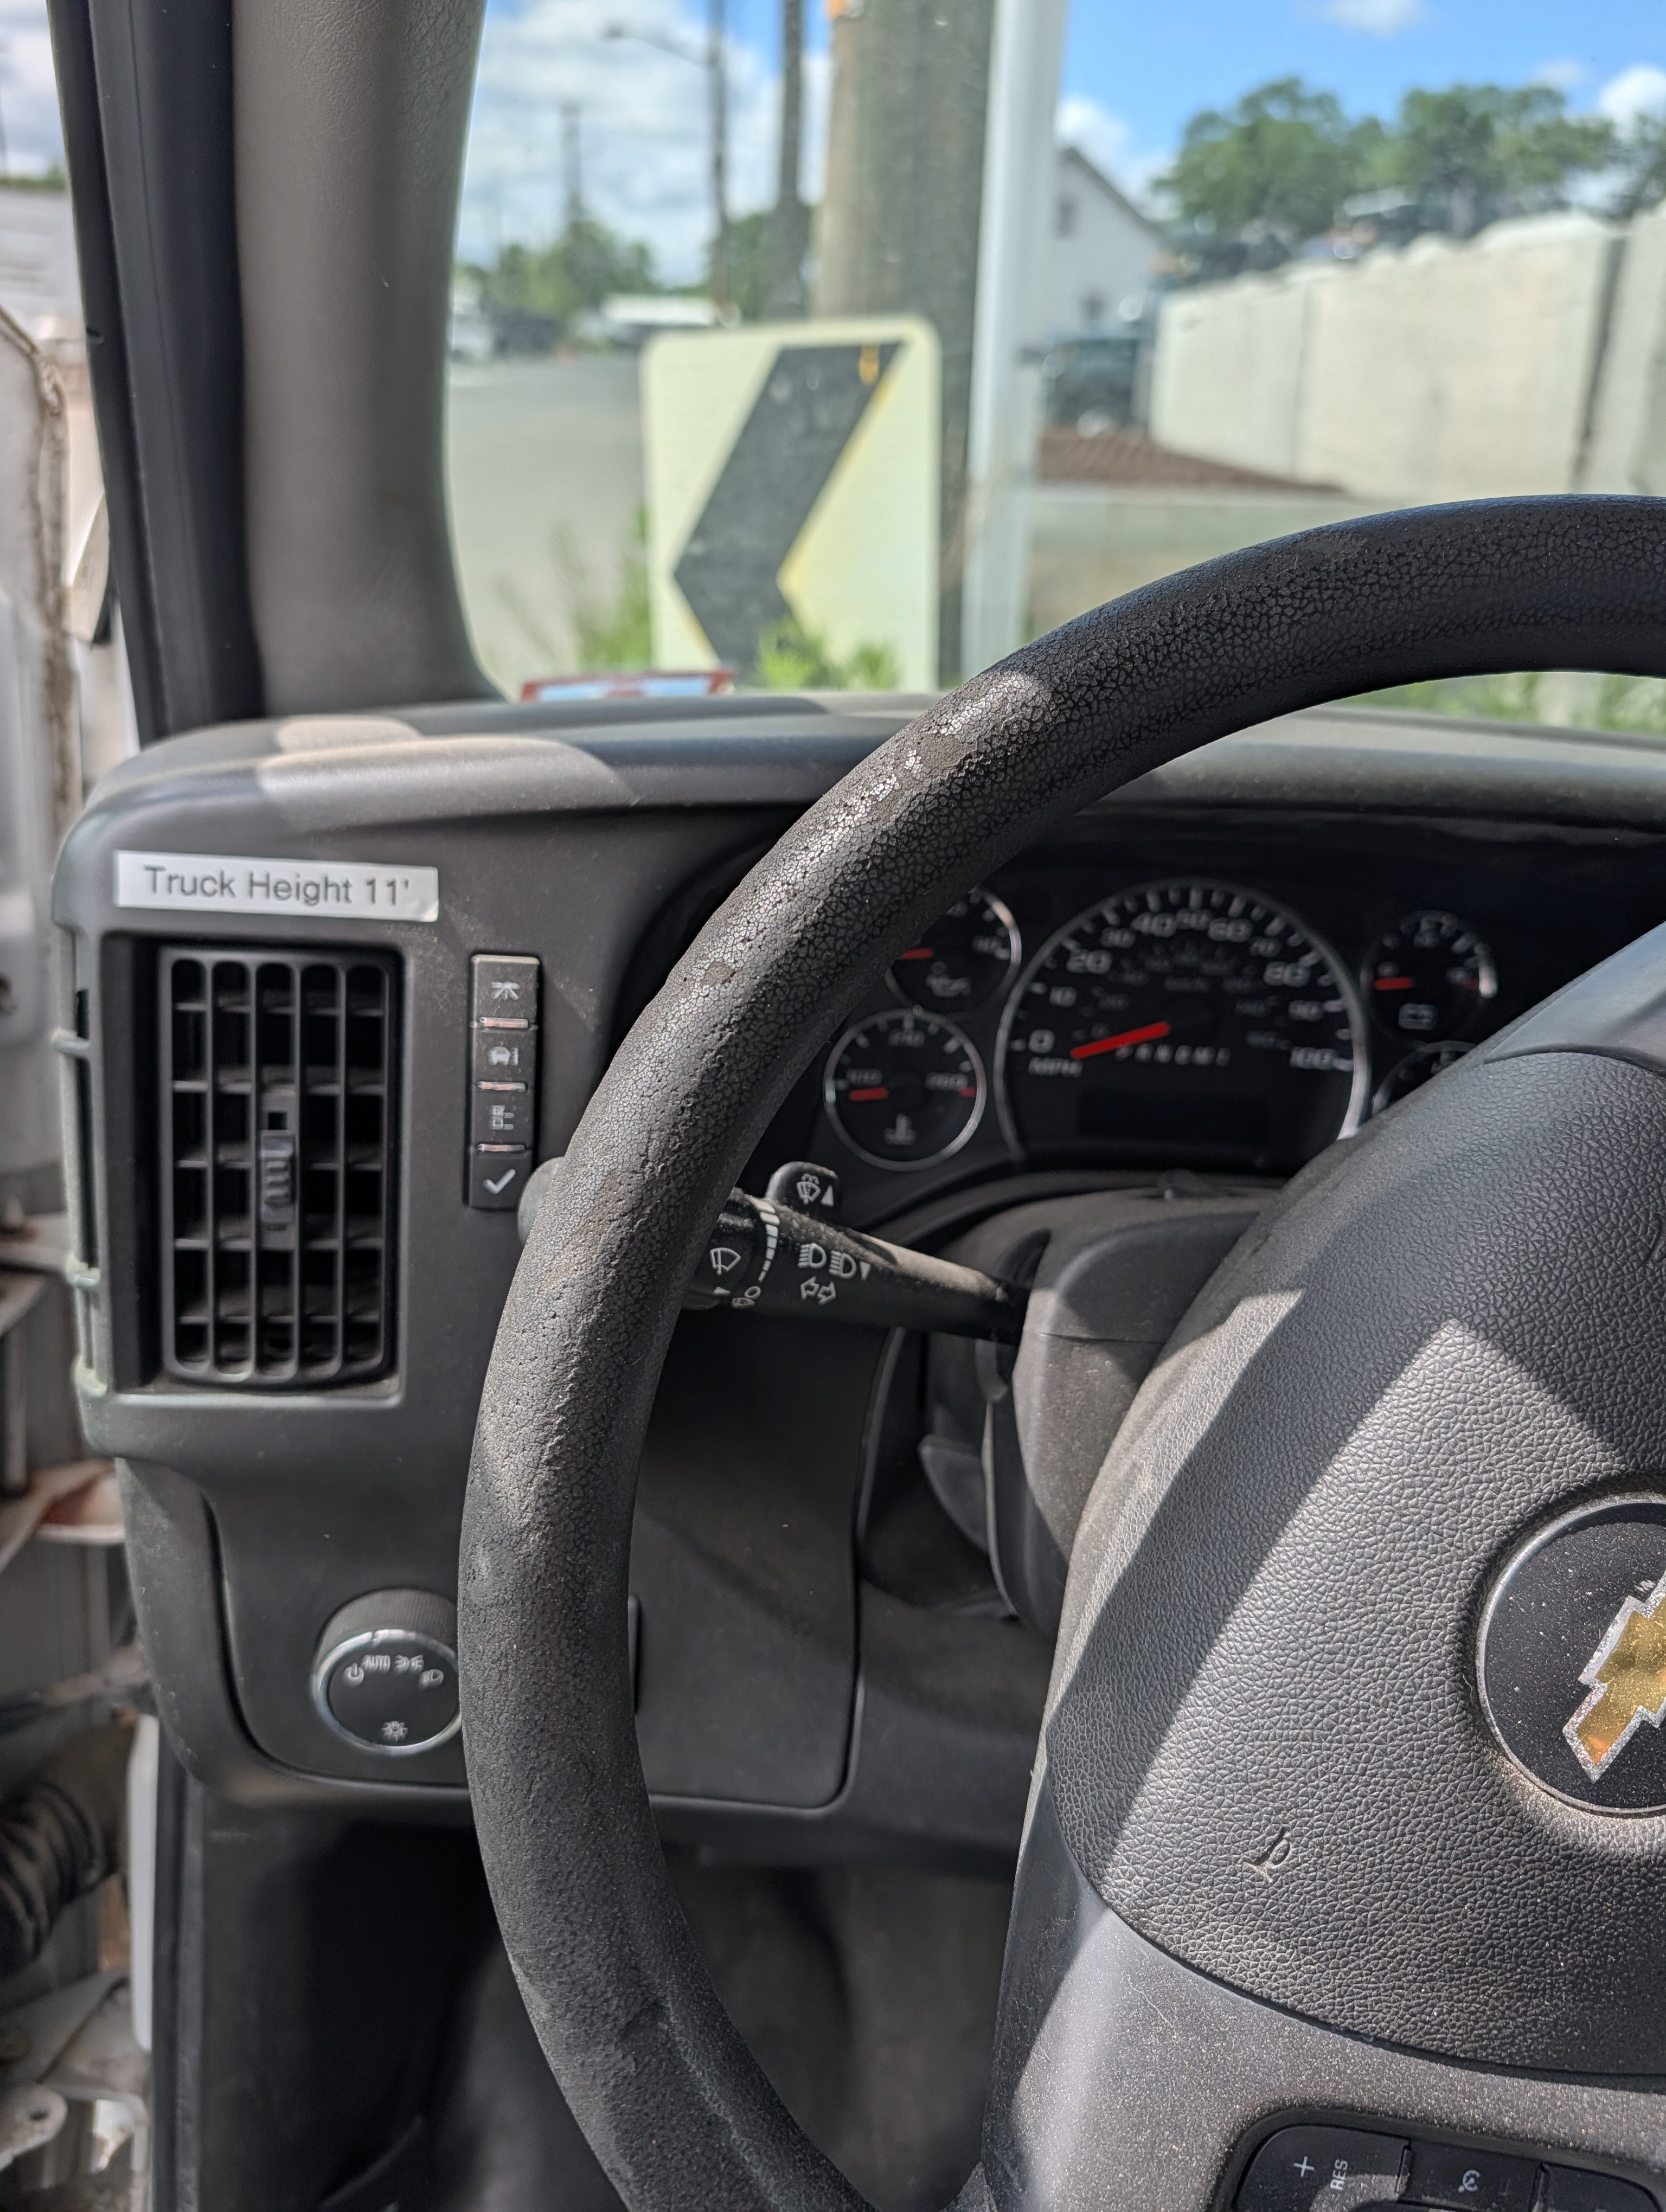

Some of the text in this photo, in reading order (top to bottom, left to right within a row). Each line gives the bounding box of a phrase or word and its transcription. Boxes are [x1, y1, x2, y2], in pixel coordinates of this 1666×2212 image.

[144, 865, 409, 906] Truck Height 11'
[1130, 912, 1176, 937] 40
[1066, 949, 1112, 973] 20
[1028, 1030, 1055, 1053] 0
[1028, 1057, 1084, 1077] MPH
[1290, 1047, 1337, 1070] 100
[1330, 2159, 1348, 2191] RES
